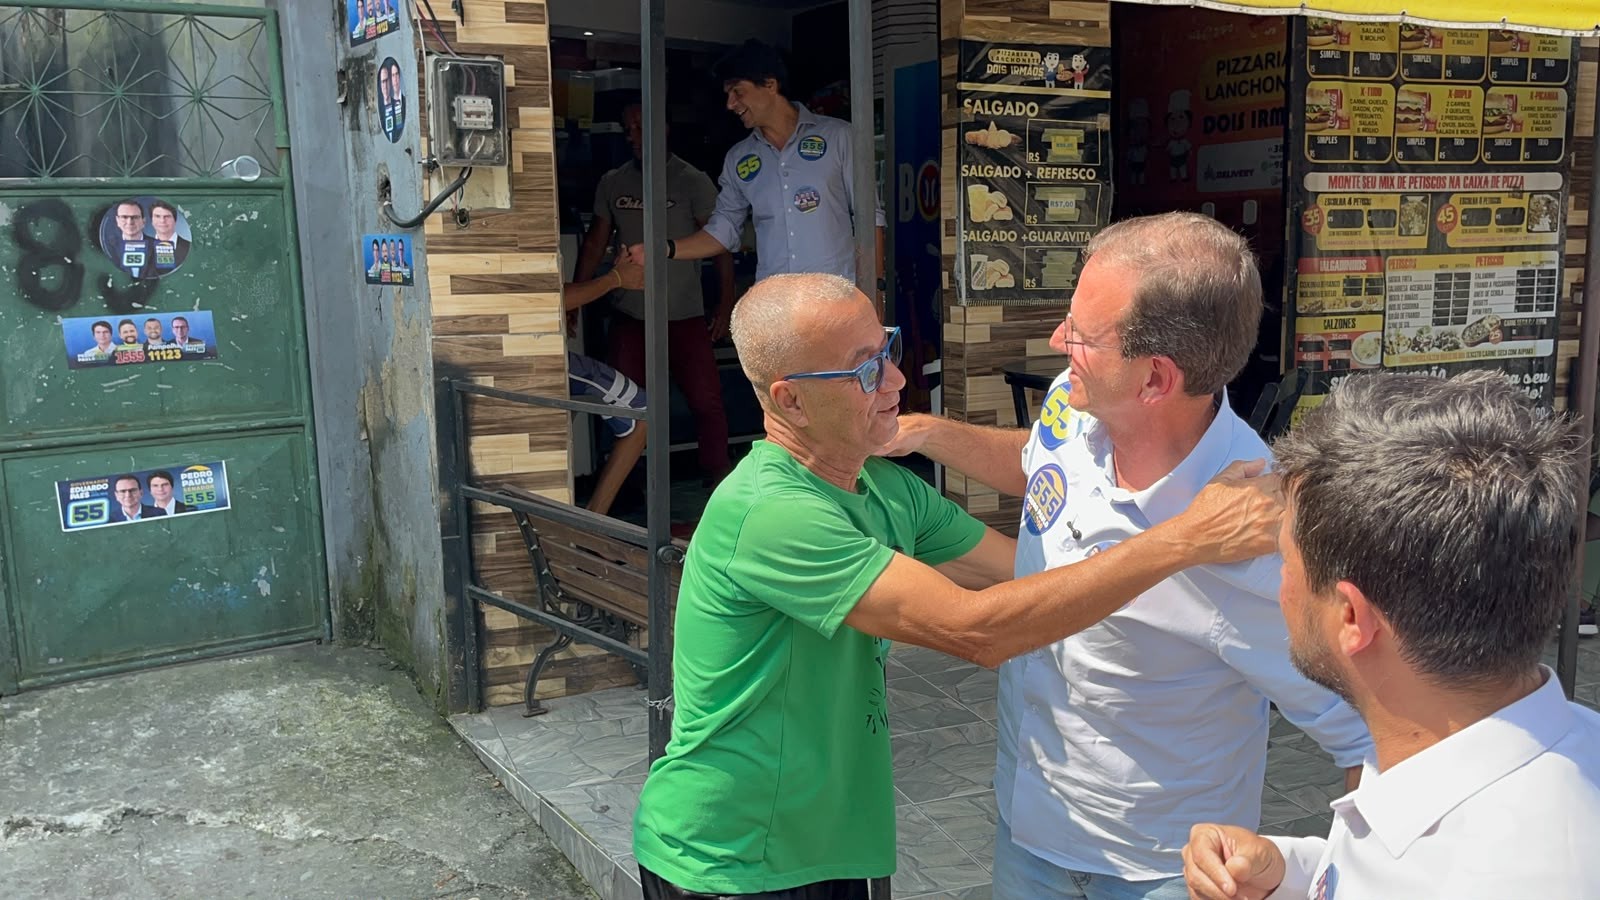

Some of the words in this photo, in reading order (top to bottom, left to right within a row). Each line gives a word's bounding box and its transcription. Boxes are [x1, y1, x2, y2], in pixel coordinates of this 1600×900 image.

[986, 64, 1007, 74] DOIS
[963, 98, 1039, 117] SALGADO
[1204, 112, 1245, 134] DOIS
[802, 141, 824, 150] 555
[1028, 151, 1040, 162] R$
[737, 156, 761, 180] 55
[961, 165, 1021, 179] SALGADO
[1037, 167, 1096, 180] REFRESCO
[1216, 169, 1254, 178] DELIVERY
[1328, 176, 1360, 189] MONTE
[1362, 176, 1376, 189] SEU
[1380, 176, 1395, 189] MIX
[1398, 176, 1406, 189] DE
[1408, 176, 1446, 189] PETISCOS
[1449, 176, 1460, 188] NA
[1463, 176, 1488, 188] CAIXA
[1491, 176, 1500, 188] DE
[1502, 176, 1524, 188] PIZZA
[616, 195, 676, 210] Chio
[1026, 215, 1037, 224] R$
[1438, 207, 1454, 223] 45
[962, 231, 1017, 242] SALGADO
[126, 255, 142, 263] 55
[1025, 278, 1036, 288] R$
[1324, 318, 1356, 330] CALZONES
[116, 351, 145, 363] 1555
[148, 349, 181, 361] 11123
[1523, 373, 1550, 384] seu
[1040, 386, 1070, 440] 55
[180, 471, 212, 480] PEDRO
[70, 479, 108, 487] GOVERNADOR
[182, 478, 214, 487] PAULO
[184, 484, 214, 492] SENADOR
[70, 484, 109, 494] EDUARDO
[185, 492, 215, 504] 555
[1032, 476, 1059, 517] 555
[74, 505, 104, 521] 55
